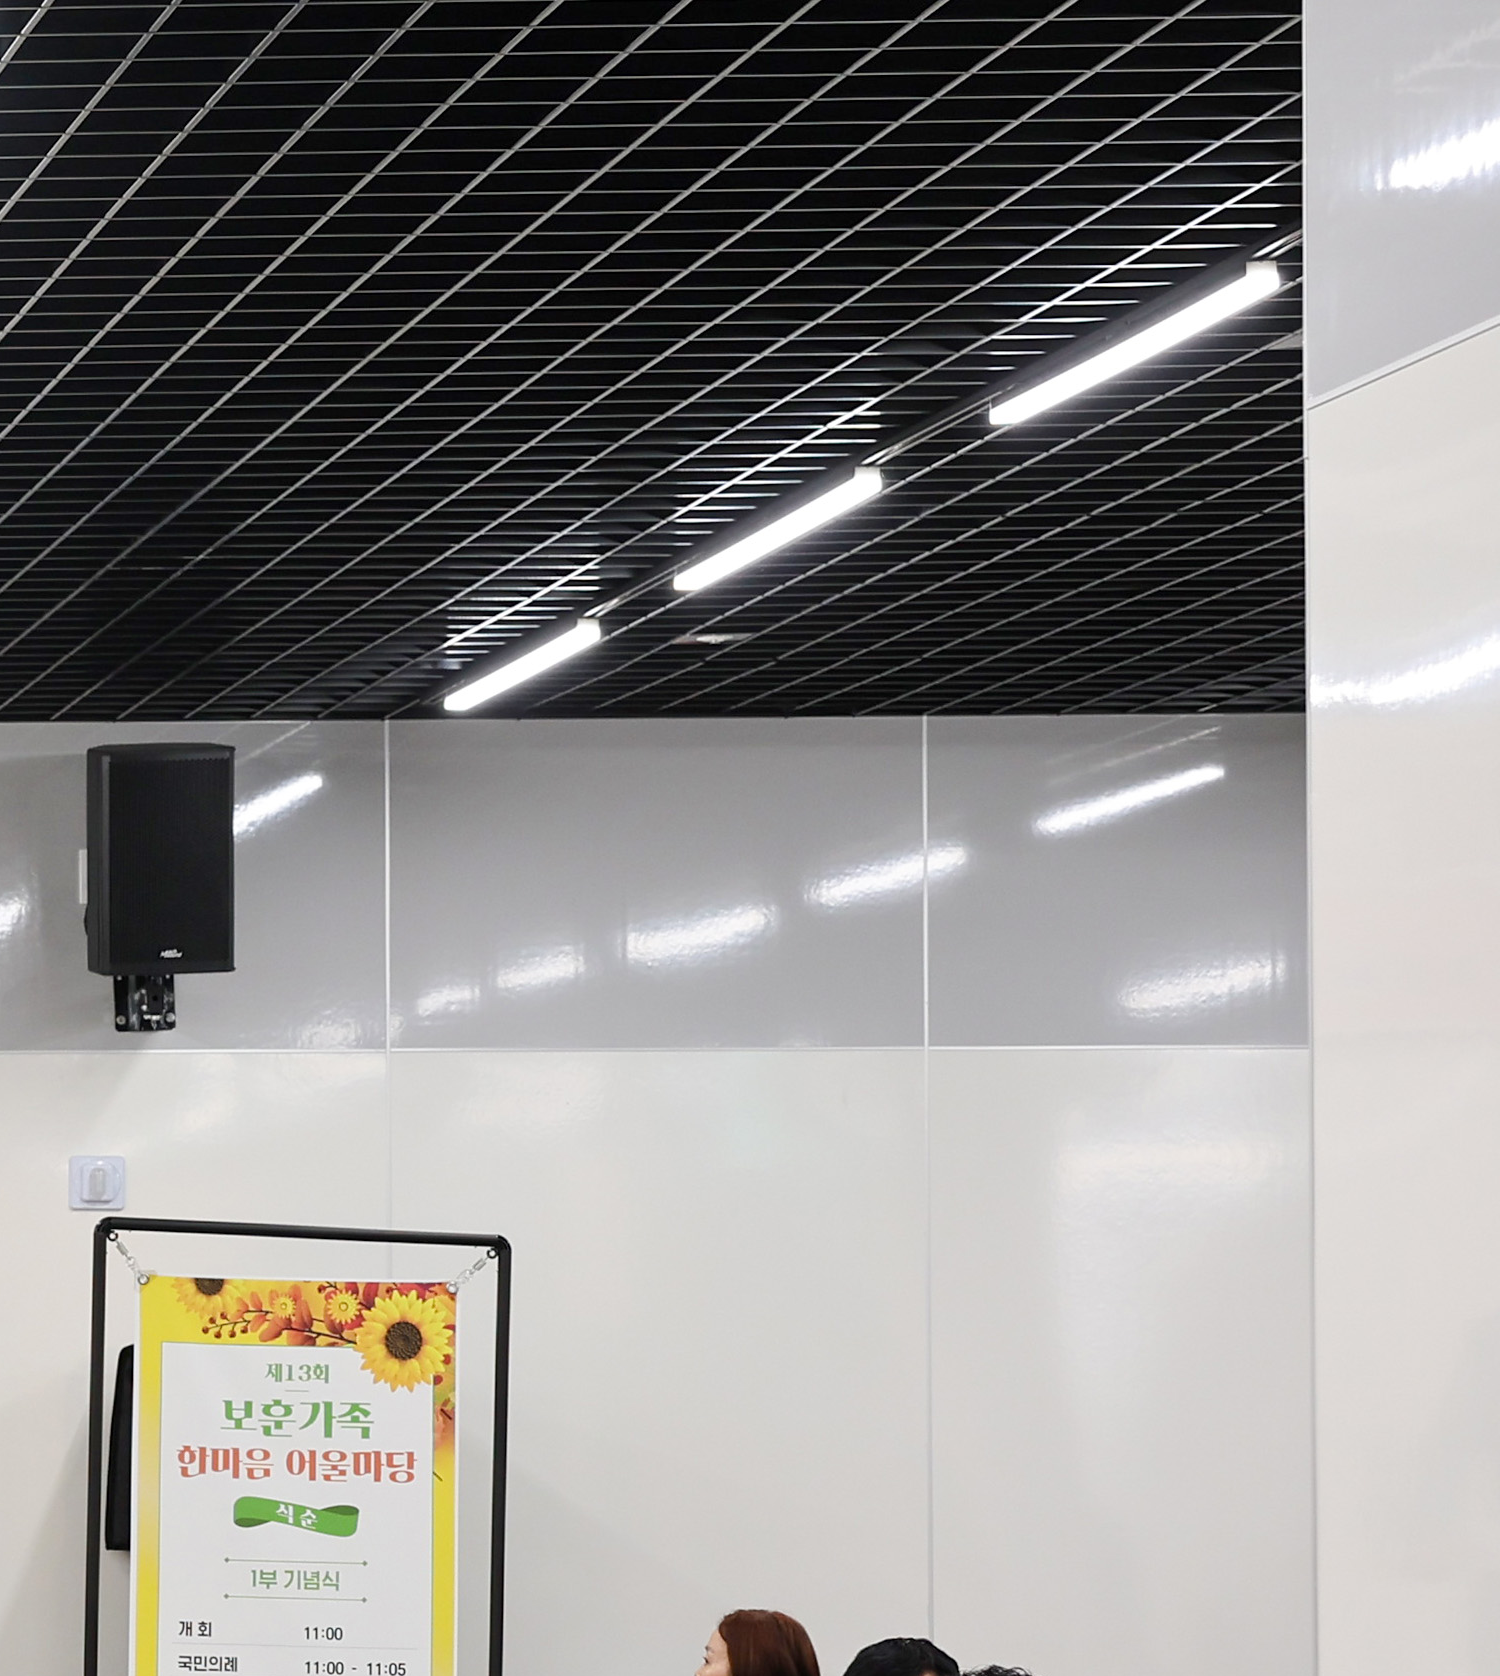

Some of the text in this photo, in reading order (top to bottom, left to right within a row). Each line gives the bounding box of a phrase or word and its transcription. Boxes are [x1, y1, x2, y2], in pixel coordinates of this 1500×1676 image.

[265, 1363, 330, 1384] 제13회
[220, 1399, 374, 1439] 보훈가족
[177, 1445, 418, 1483] 한마음 어울마당
[251, 1569, 340, 1591] 1부 기념식
[304, 1627, 343, 1641] 11:00
[177, 1655, 238, 1673] 국민의례
[304, 1661, 344, 1675] 11:00
[366, 1663, 406, 1676] 11:05
